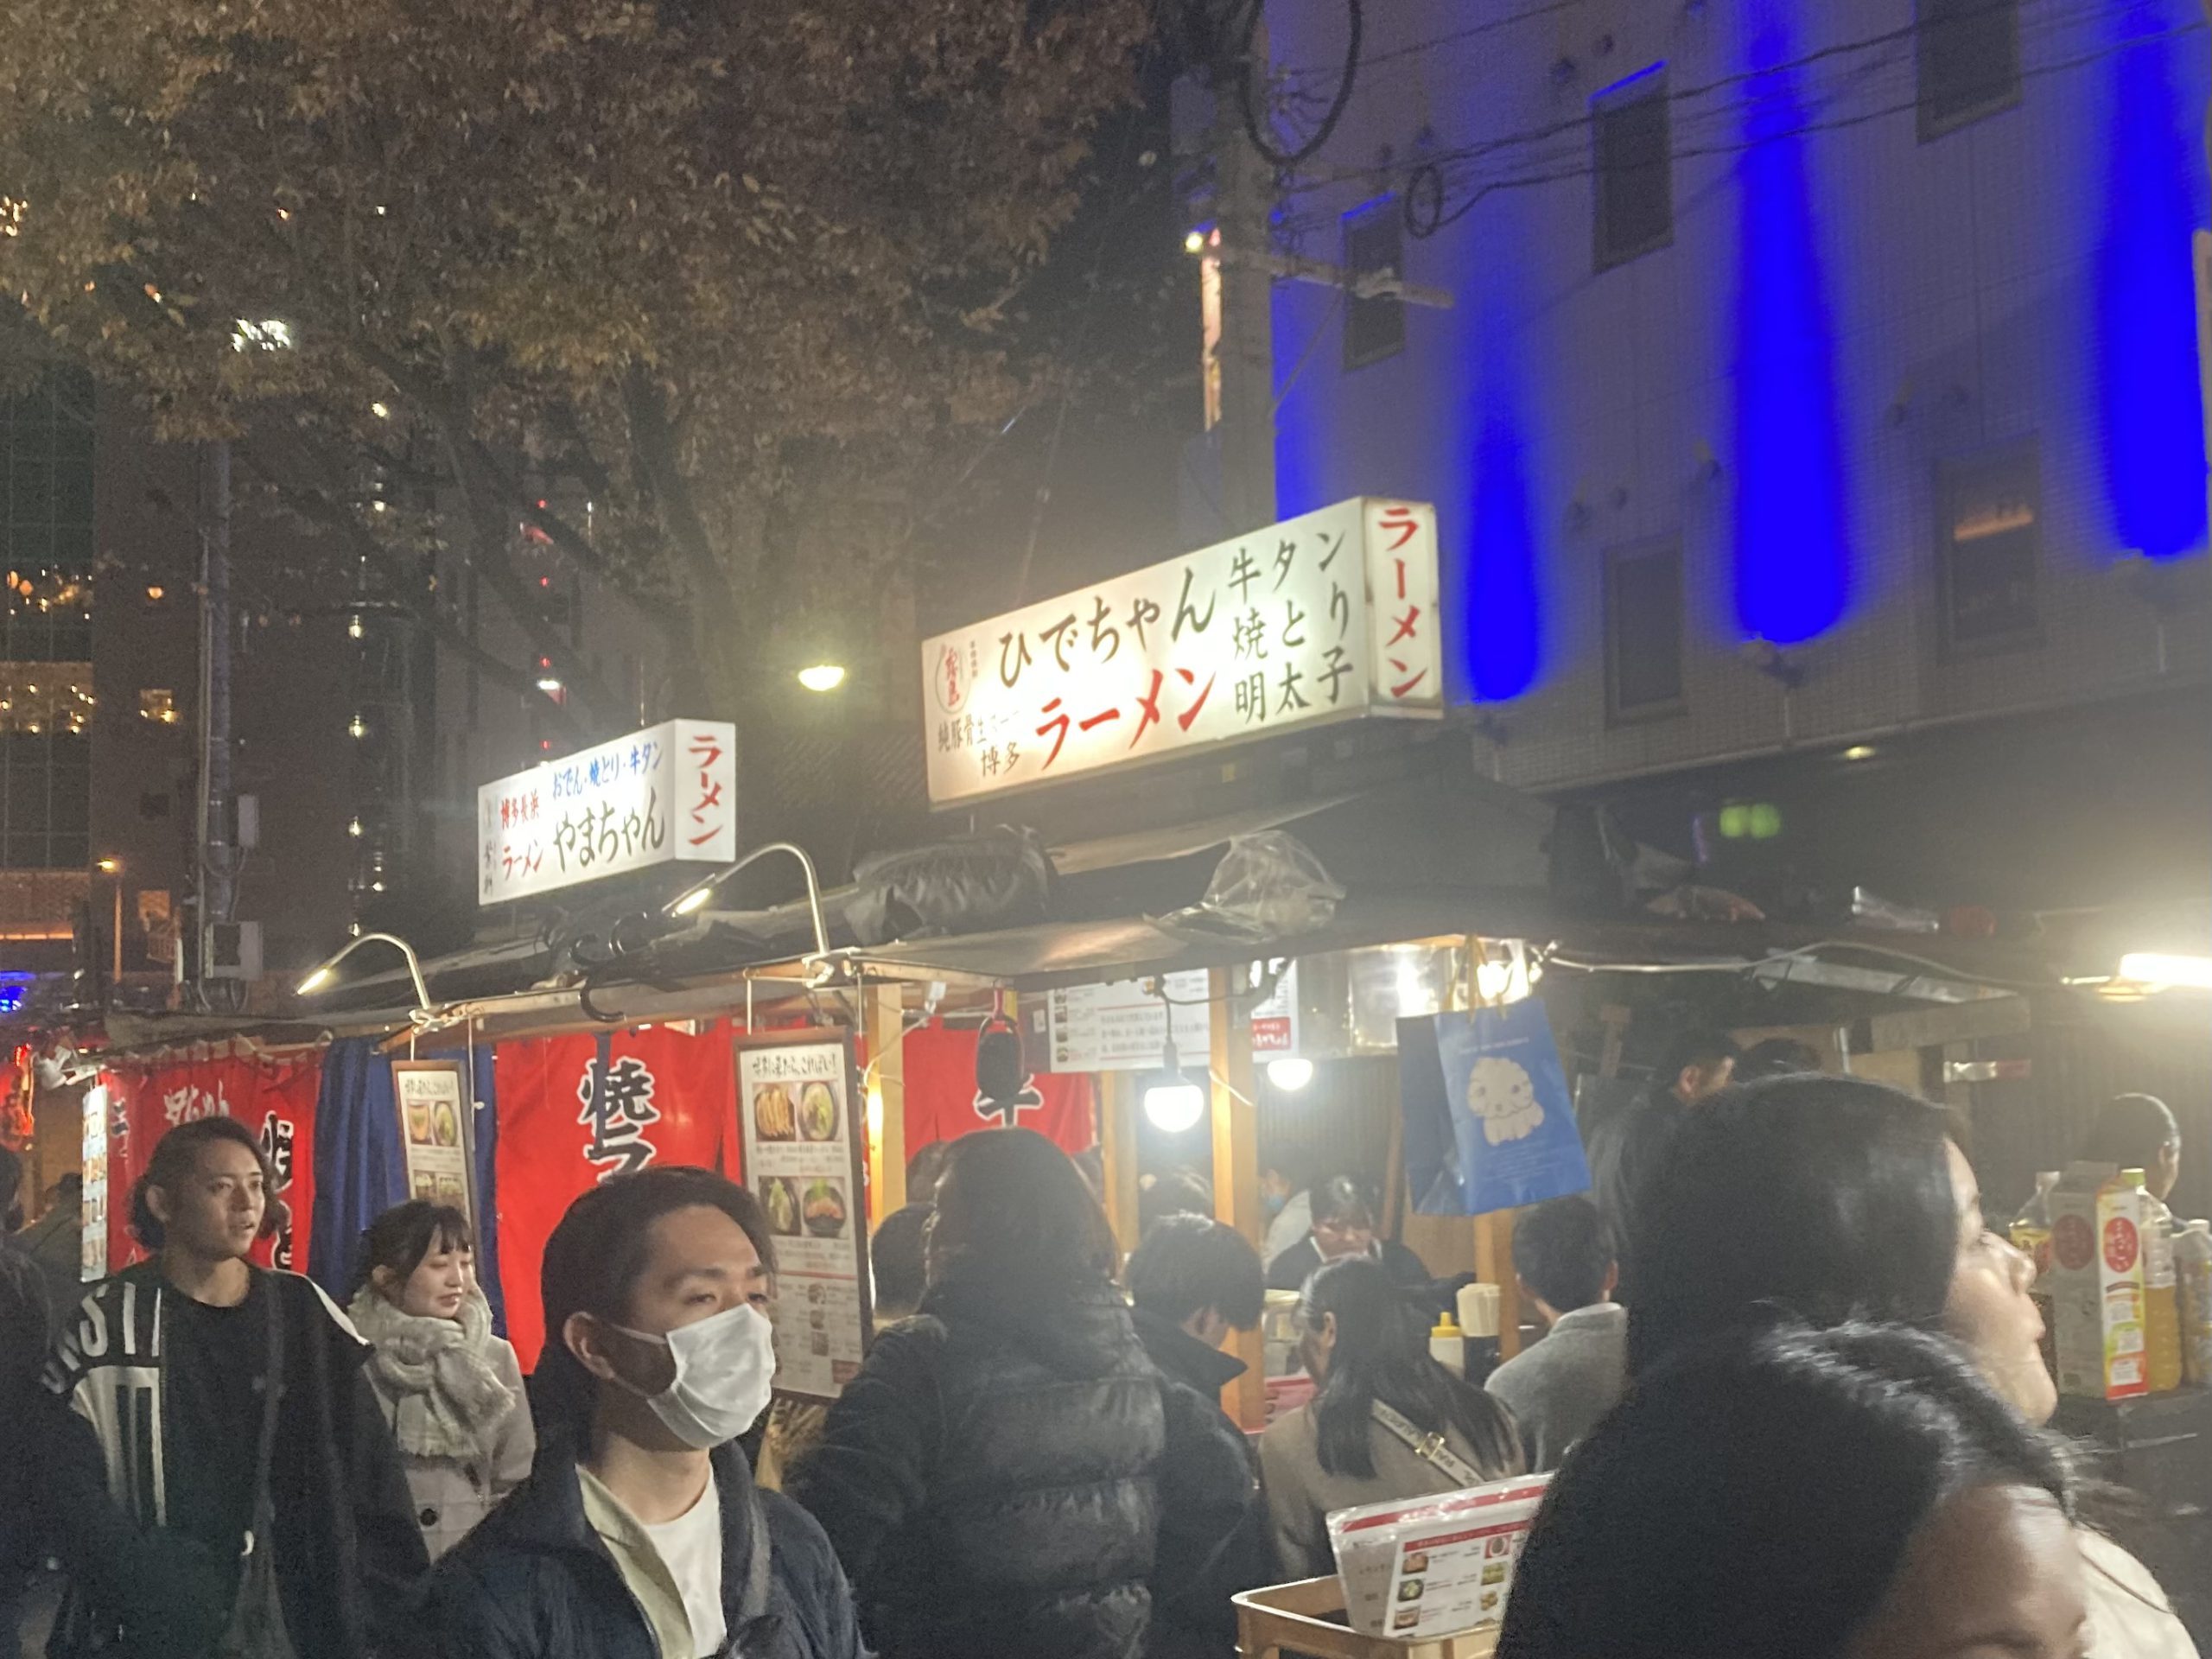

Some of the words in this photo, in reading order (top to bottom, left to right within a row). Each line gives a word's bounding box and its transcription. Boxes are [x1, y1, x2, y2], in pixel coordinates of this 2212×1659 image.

[1228, 531, 1345, 604] 牛タン
[1377, 508, 1428, 699] ラーメン
[999, 566, 1216, 689] ひでちゃん
[1234, 581, 1351, 661] 焼とり
[981, 741, 1020, 777] 博多
[1036, 668, 1217, 772] ラーメン
[1235, 645, 1354, 725] 明太子
[553, 785, 665, 873] やまちゃん
[688, 735, 723, 846] ラーメン
[502, 839, 543, 880] ラーメン
